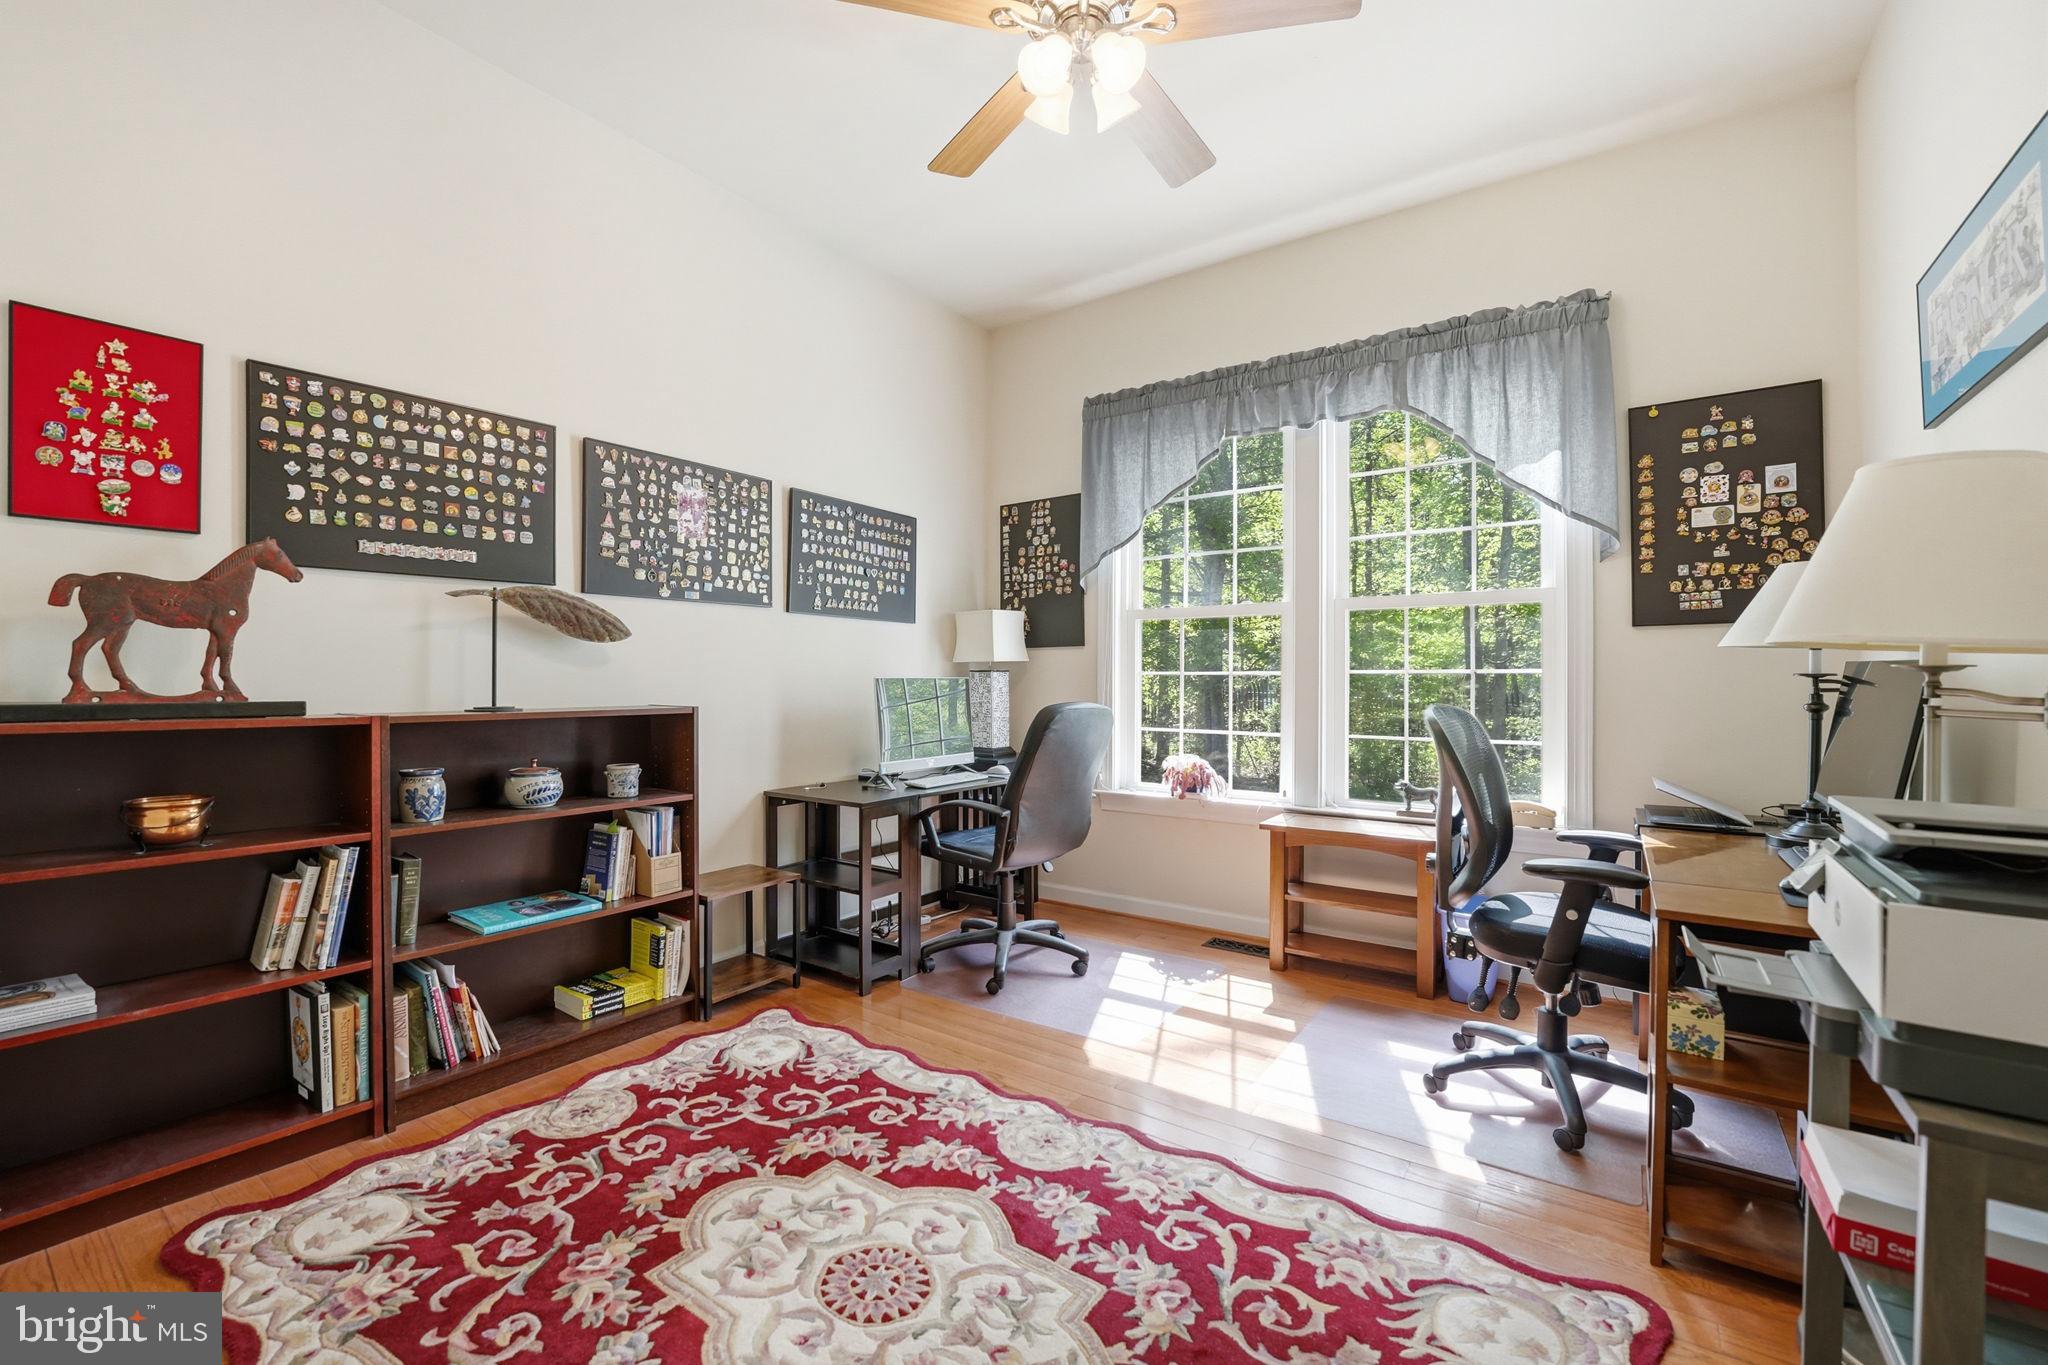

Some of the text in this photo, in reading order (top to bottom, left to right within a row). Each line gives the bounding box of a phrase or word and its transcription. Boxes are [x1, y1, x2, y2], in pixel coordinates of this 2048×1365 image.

[321, 1014, 329, 1029] Step
[322, 1029, 330, 1045] Right
[1887, 1242, 1915, 1258] Cop
